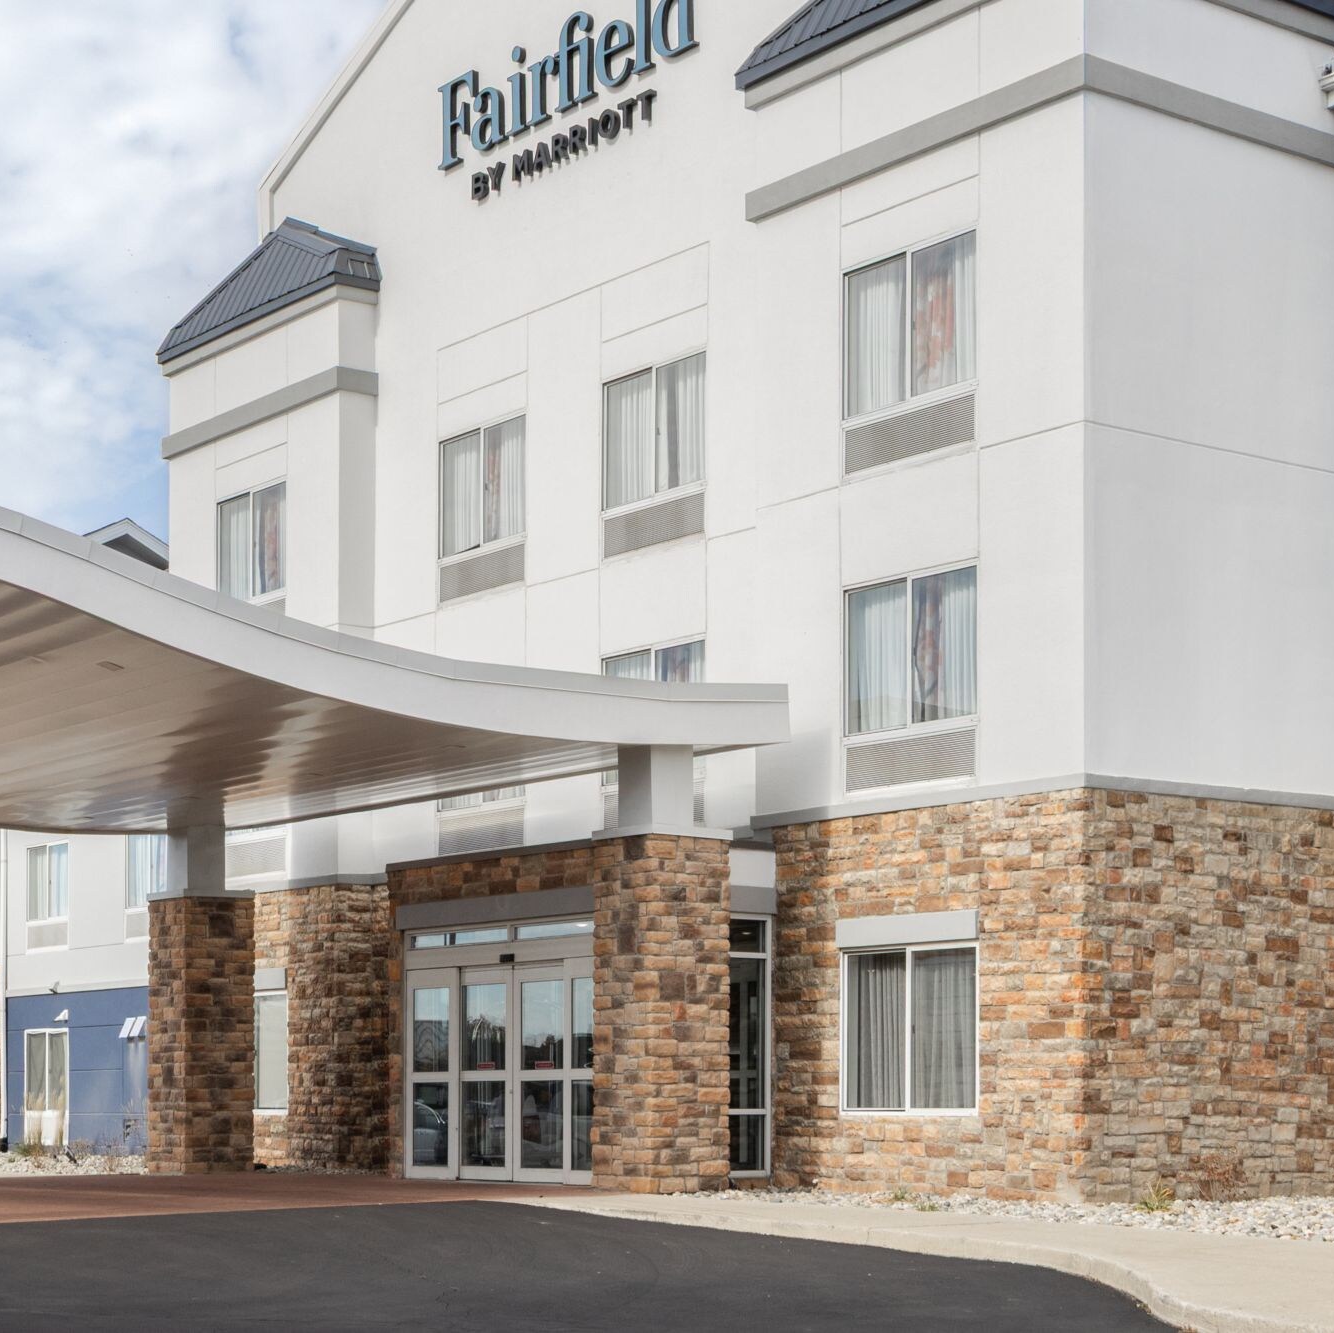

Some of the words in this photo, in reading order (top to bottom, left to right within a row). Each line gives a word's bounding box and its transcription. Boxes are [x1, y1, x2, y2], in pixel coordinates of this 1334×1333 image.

[438, 0, 700, 171] Fairfield
[471, 161, 506, 201] BY
[512, 88, 657, 182] MARRIOTT
